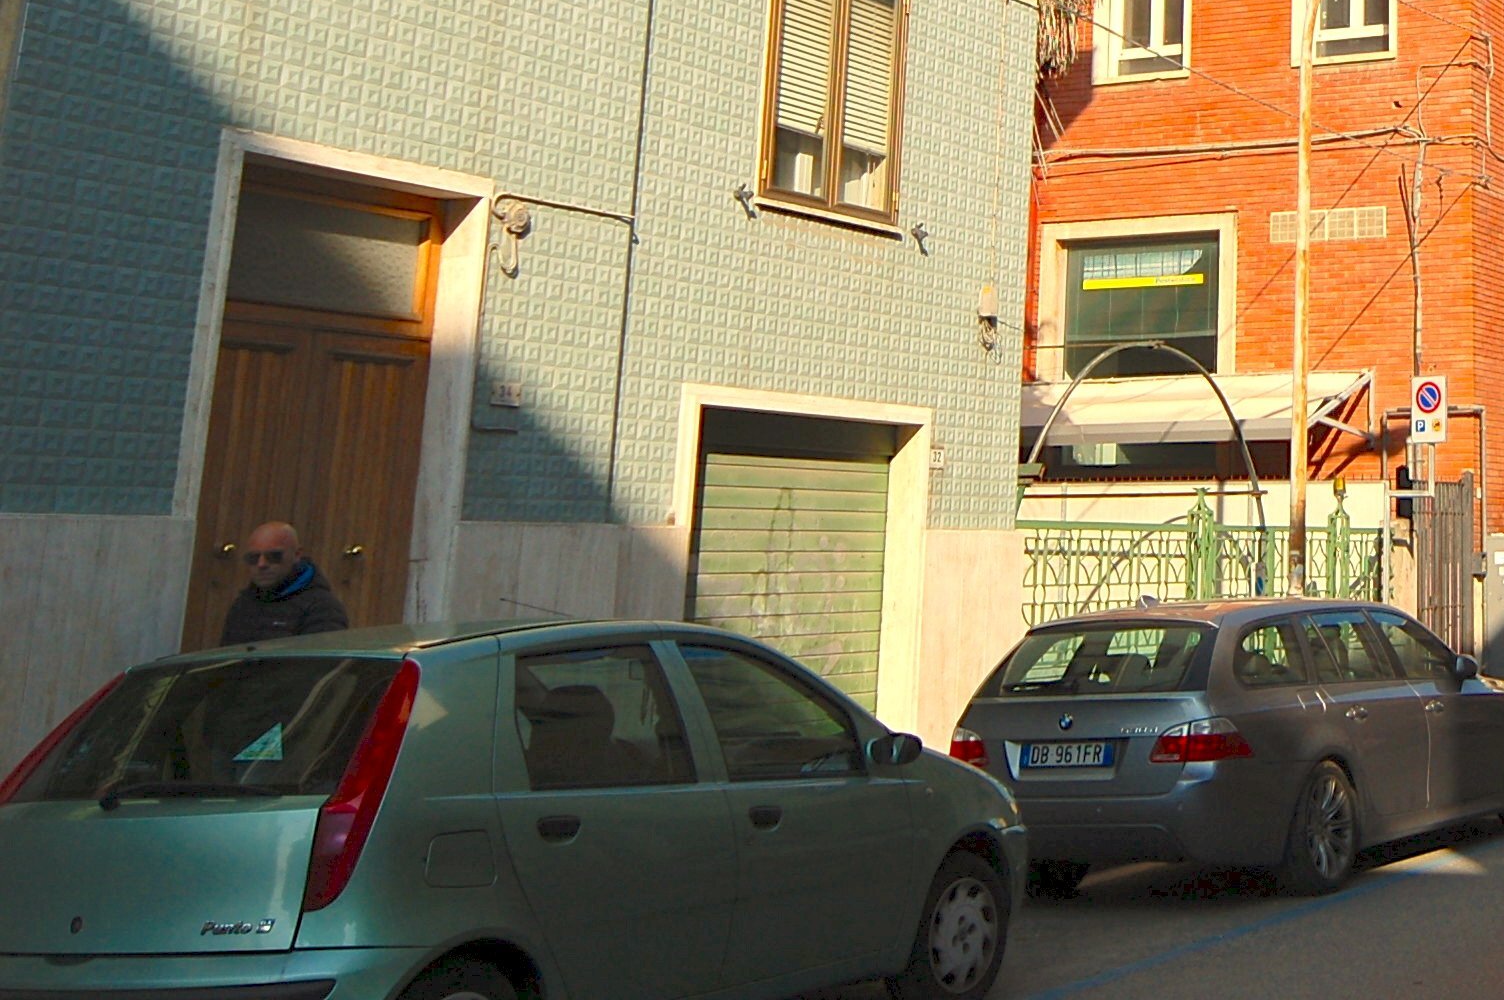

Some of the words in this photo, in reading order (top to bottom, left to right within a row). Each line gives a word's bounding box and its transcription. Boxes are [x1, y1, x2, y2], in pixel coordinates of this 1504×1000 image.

[932, 451, 942, 463] 32
[1030, 746, 1050, 765] DB
[1055, 744, 1102, 764] 961FR
